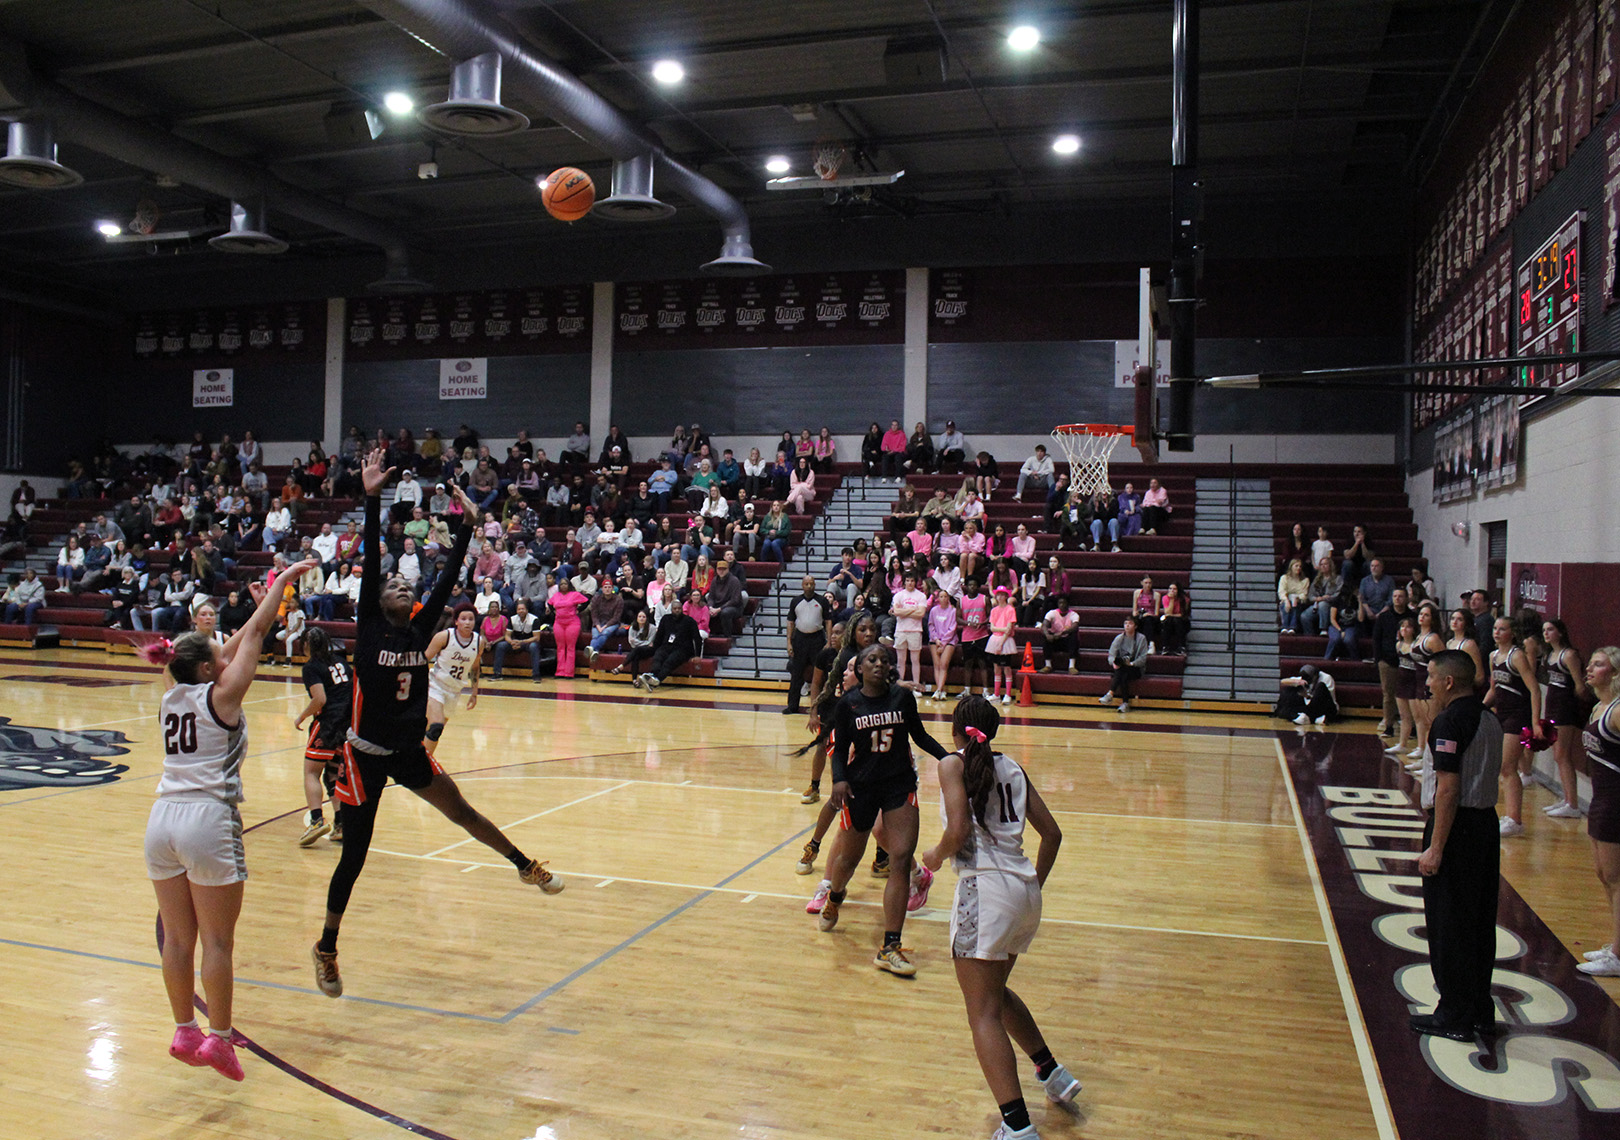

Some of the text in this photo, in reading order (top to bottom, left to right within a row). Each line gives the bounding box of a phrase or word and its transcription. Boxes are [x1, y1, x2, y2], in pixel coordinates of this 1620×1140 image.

[1564, 248, 1577, 291] 27
[736, 307, 766, 326] DOGS
[775, 306, 806, 324] DOGS
[816, 303, 848, 321] DOGS
[859, 302, 891, 321] DOGS
[935, 299, 968, 318] DOGS
[1521, 289, 1531, 325] 28
[620, 313, 649, 332] DOGS
[658, 310, 687, 328] DOGS
[697, 308, 727, 326] DOGS
[200, 384, 226, 393] HOME
[448, 376, 478, 384] HOME
[193, 396, 232, 405] SEATING
[441, 388, 485, 396] SEATING
[378, 650, 427, 667] ORGINA
[451, 651, 471, 664] Dogs
[329, 662, 349, 685] 22
[449, 665, 465, 681] 22
[396, 672, 413, 701] 3
[855, 710, 905, 731] ORIGINAL
[164, 711, 198, 755] 20
[870, 728, 894, 753] 15
[996, 782, 1020, 823] 11
